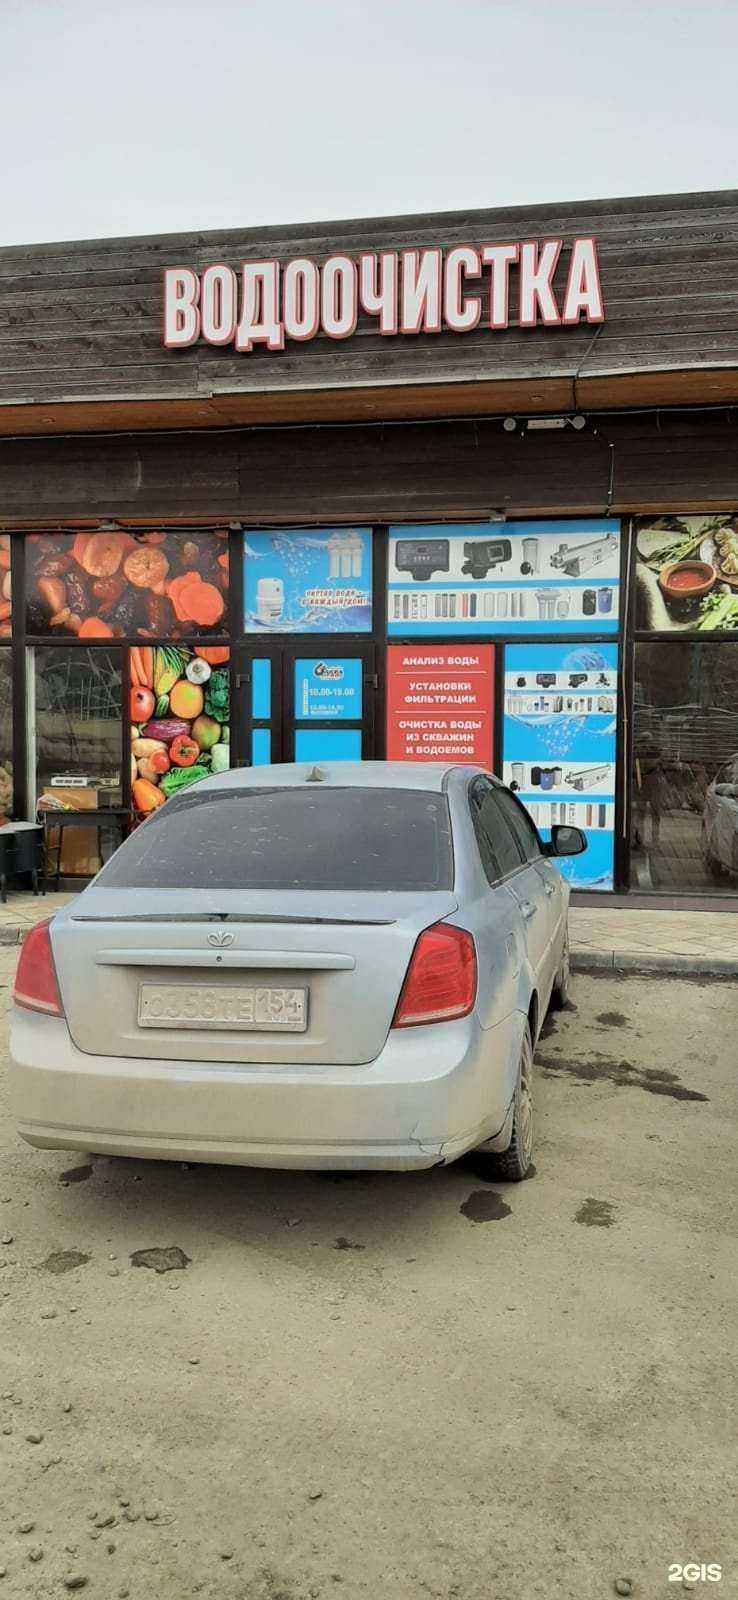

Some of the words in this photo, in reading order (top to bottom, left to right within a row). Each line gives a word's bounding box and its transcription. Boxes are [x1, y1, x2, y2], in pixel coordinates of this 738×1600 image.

[163, 237, 605, 352] ВОДООЧИСТКА
[402, 657, 445, 666] АНАЛИЗ
[447, 656, 480, 666] ВОДЫ
[409, 682, 472, 691] УСТАНОВКИ
[404, 695, 477, 704] ФИЛЬТРАЦИИ
[398, 720, 447, 729] ОЧИСТКА
[450, 720, 482, 730] ВОДЫ
[406, 733, 420, 741] ИЗ
[422, 733, 475, 741] СКВАЖИН
[405, 746, 413, 754] И
[416, 746, 475, 755] ВОДОЕМОВ
